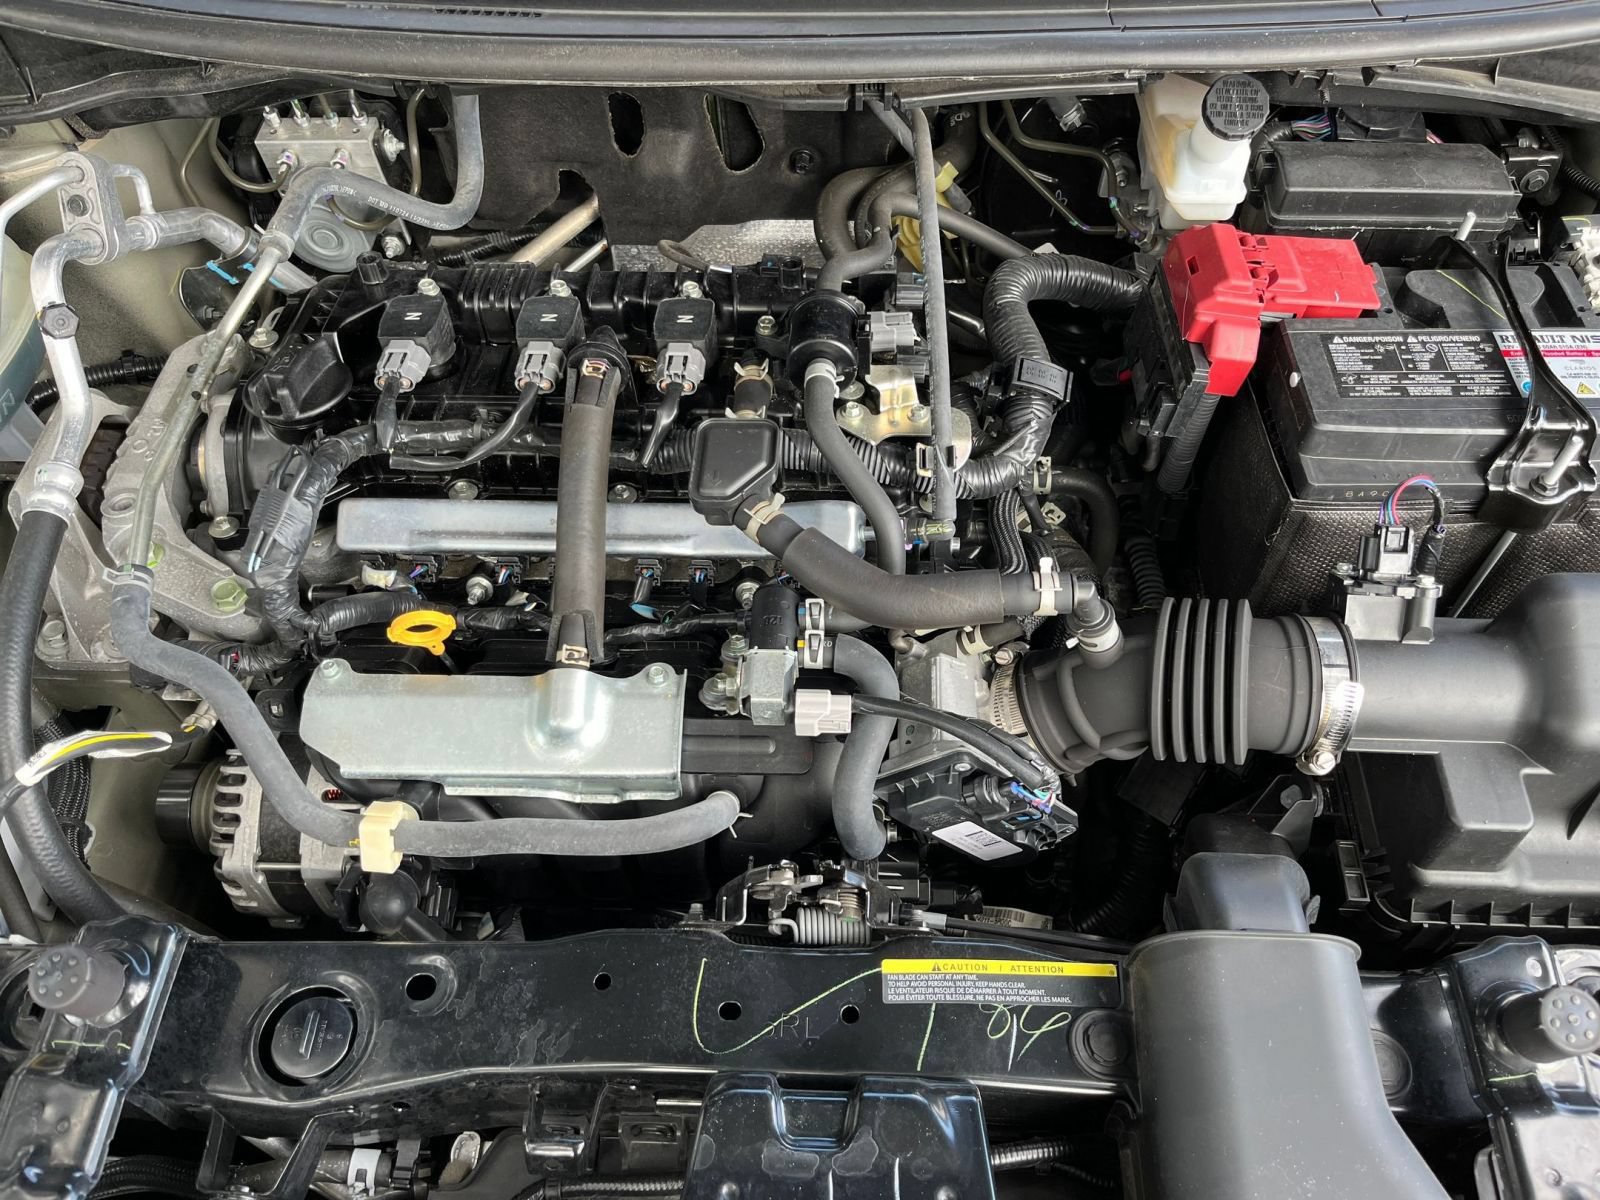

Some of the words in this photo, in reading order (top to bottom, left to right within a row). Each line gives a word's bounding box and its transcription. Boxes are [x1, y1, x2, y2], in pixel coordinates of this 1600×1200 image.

[942, 963, 988, 971] CAUTION
[1010, 964, 1064, 974] ATTENTION
[965, 987, 996, 995] DÉMARRER
[906, 993, 926, 1001] ÉVITER
[945, 994, 975, 1002] BLESSURE,
